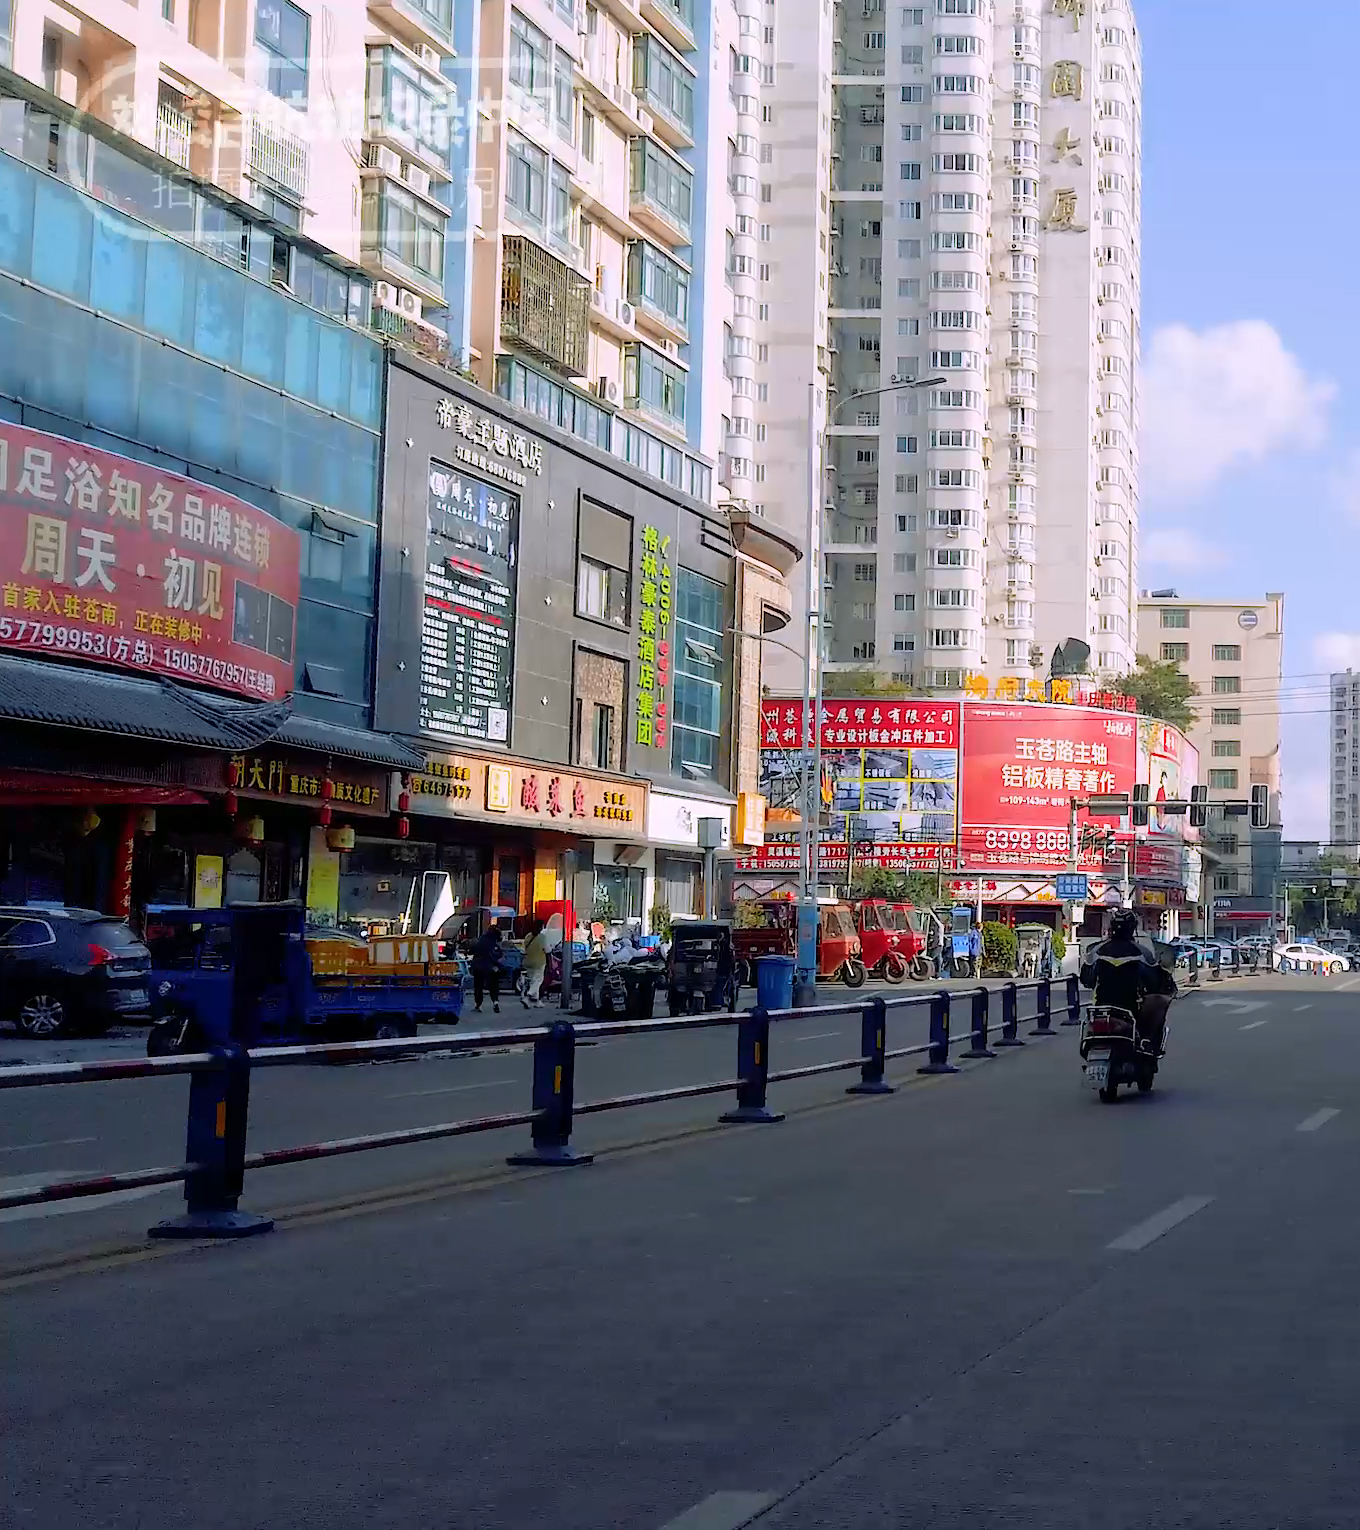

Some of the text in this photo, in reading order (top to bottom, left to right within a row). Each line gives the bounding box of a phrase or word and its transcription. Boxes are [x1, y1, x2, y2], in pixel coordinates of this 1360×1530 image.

[21, 512, 225, 622] 周天·初见
[636, 523, 658, 747] 格林豪泰酒店集团
[1001, 763, 1116, 793] 铝板精奢著作
[1014, 737, 1108, 766] 玉苍路主轴
